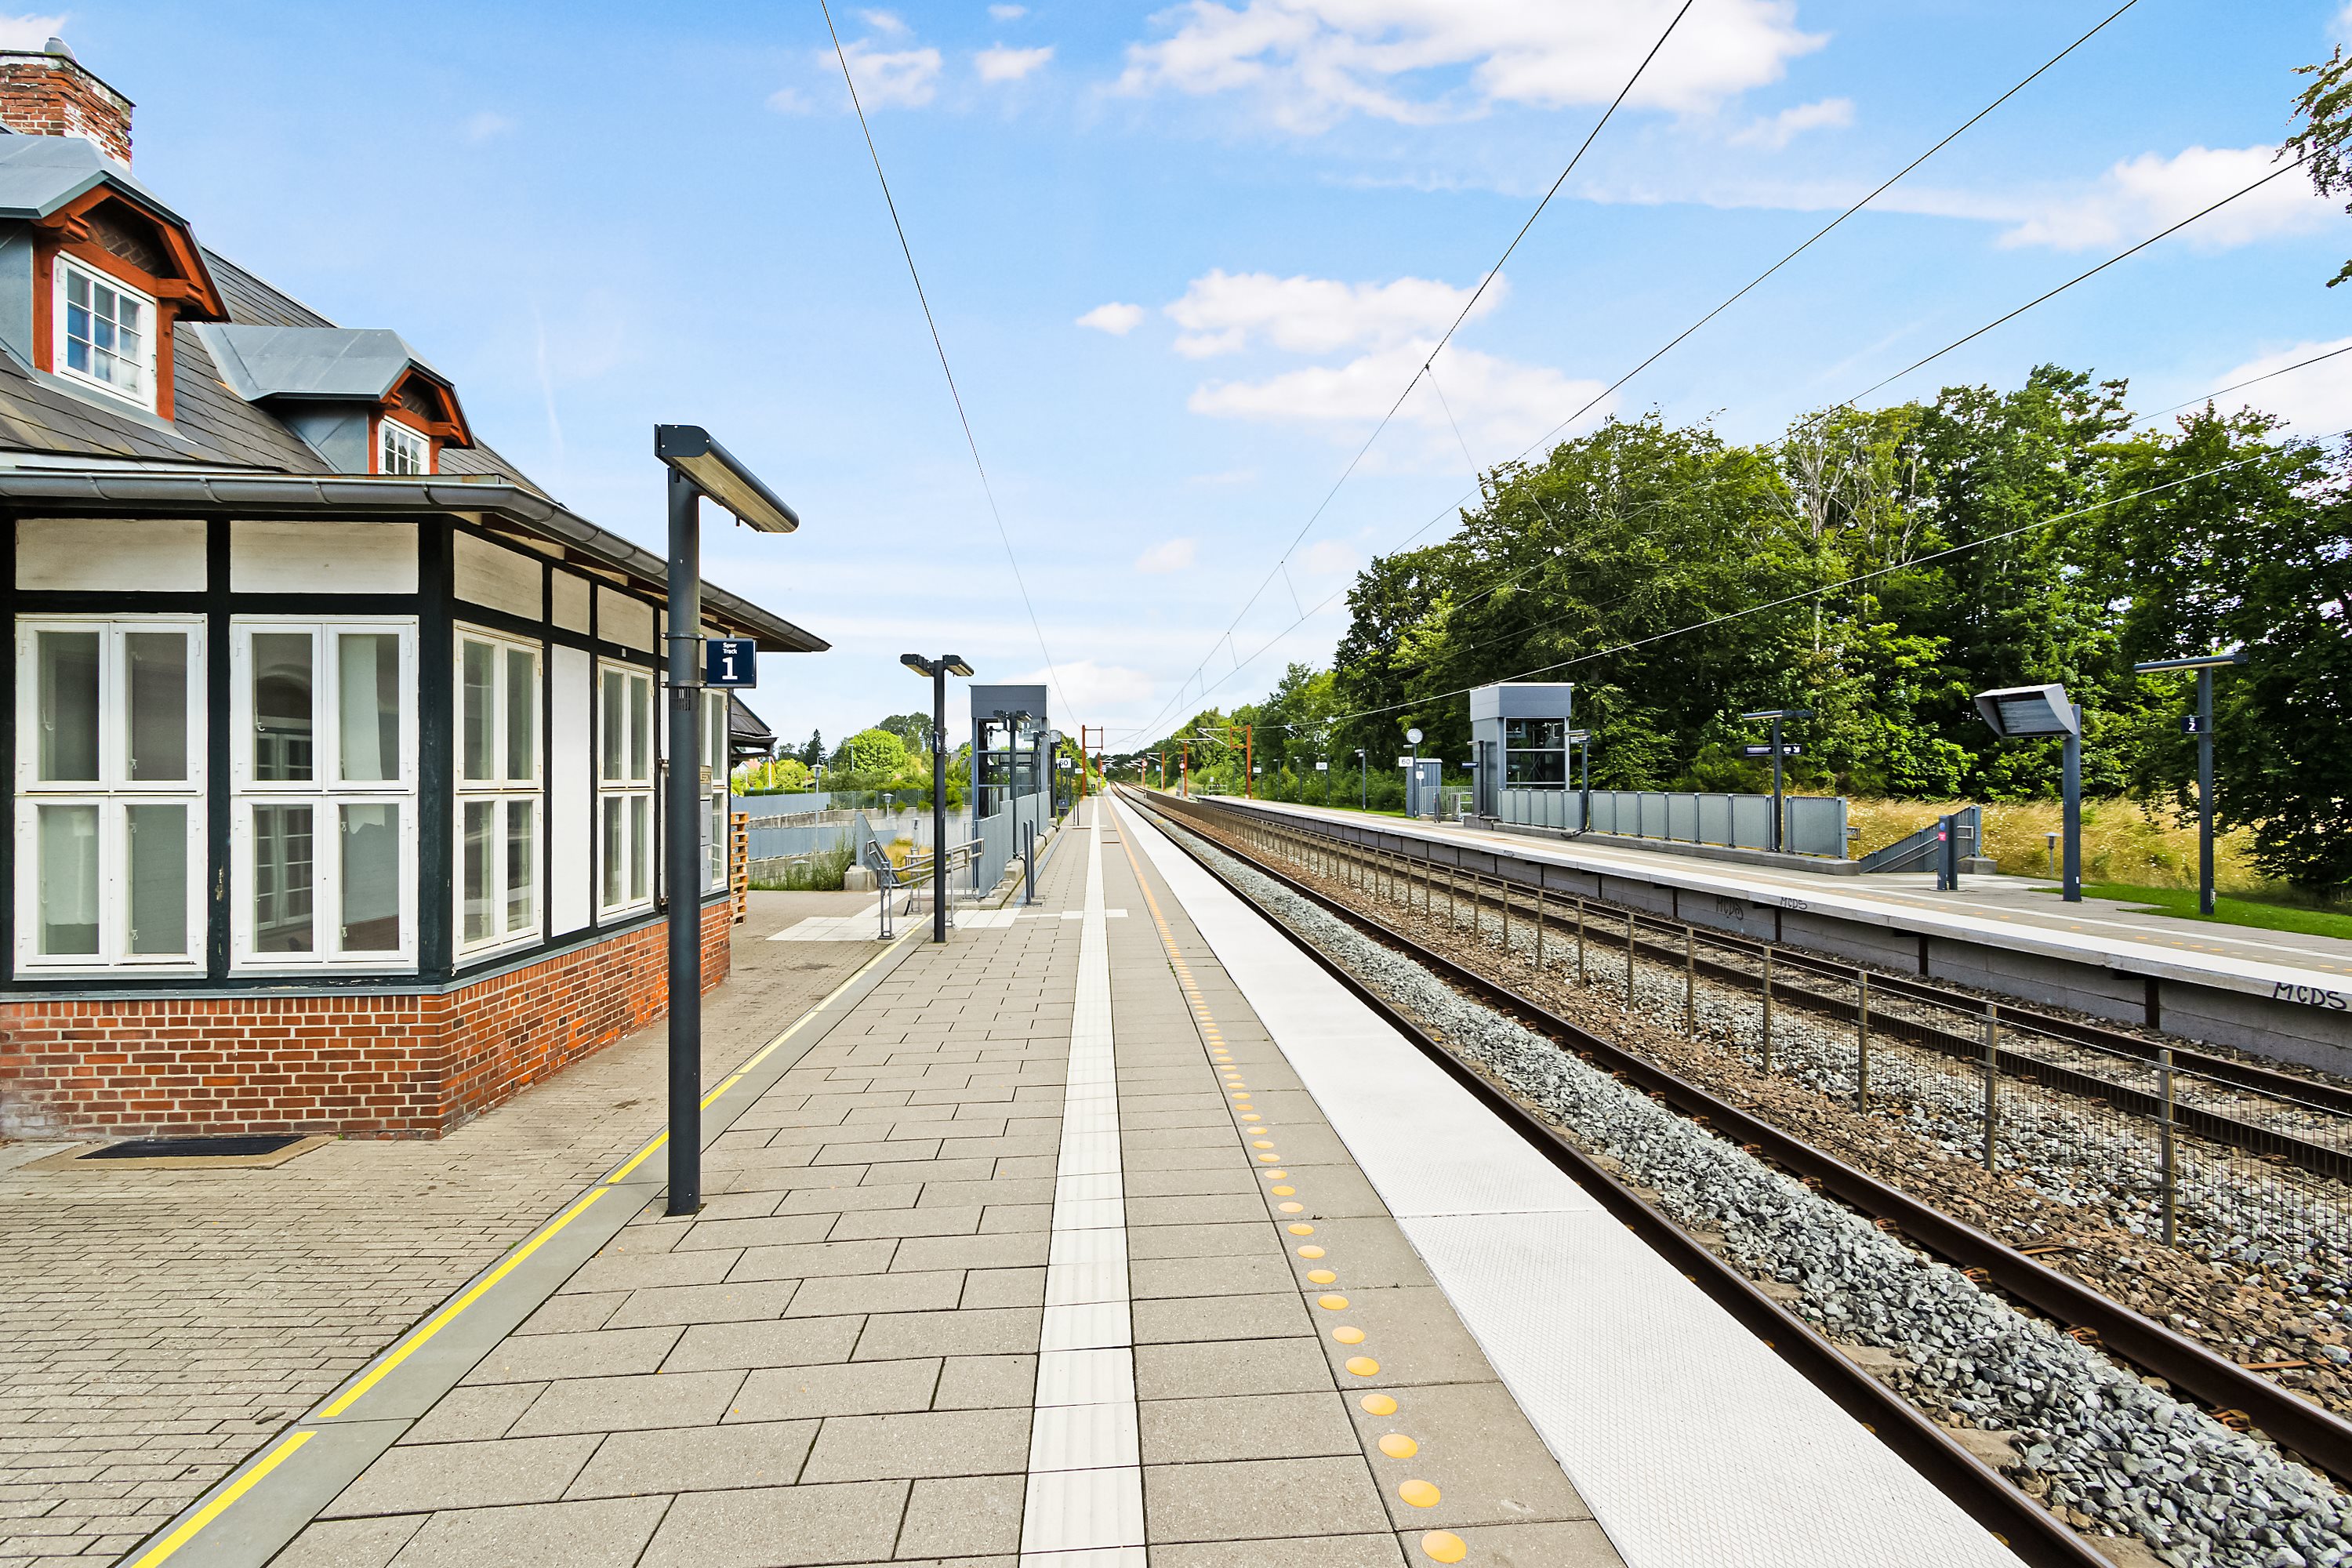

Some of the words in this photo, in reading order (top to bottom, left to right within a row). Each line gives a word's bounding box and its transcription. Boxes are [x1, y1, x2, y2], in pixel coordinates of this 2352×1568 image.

[721, 656, 739, 681] 1
[2188, 722, 2196, 731] 2
[1780, 896, 1807, 909] MCDS
[2273, 982, 2347, 1009] MCDS
